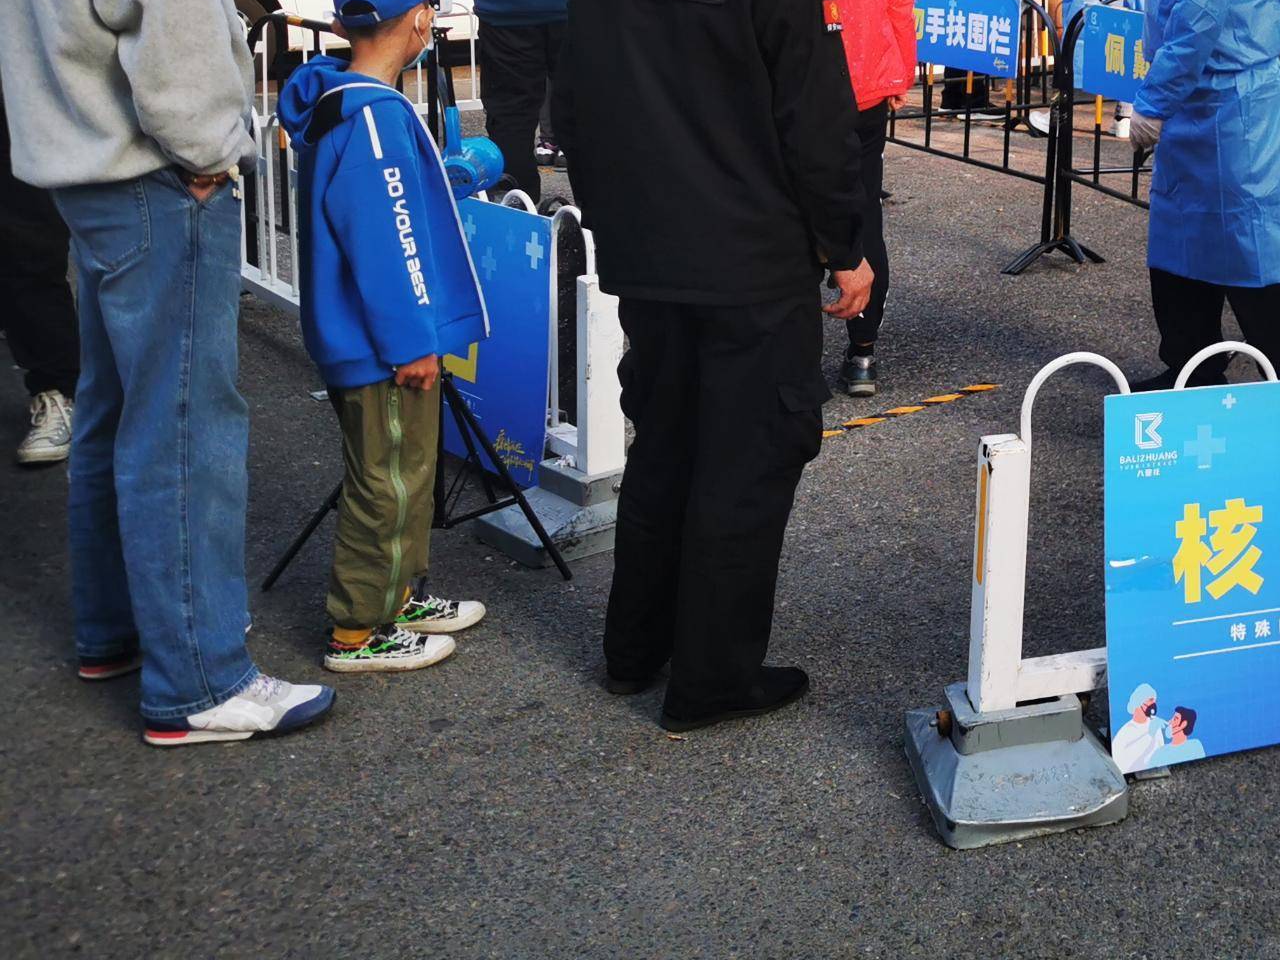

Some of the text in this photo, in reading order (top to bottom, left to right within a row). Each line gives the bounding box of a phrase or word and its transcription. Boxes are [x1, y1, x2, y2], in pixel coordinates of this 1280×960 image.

[383, 166, 431, 306] DO YOUR BEST
[1119, 450, 1178, 465] BALIZHUANG
